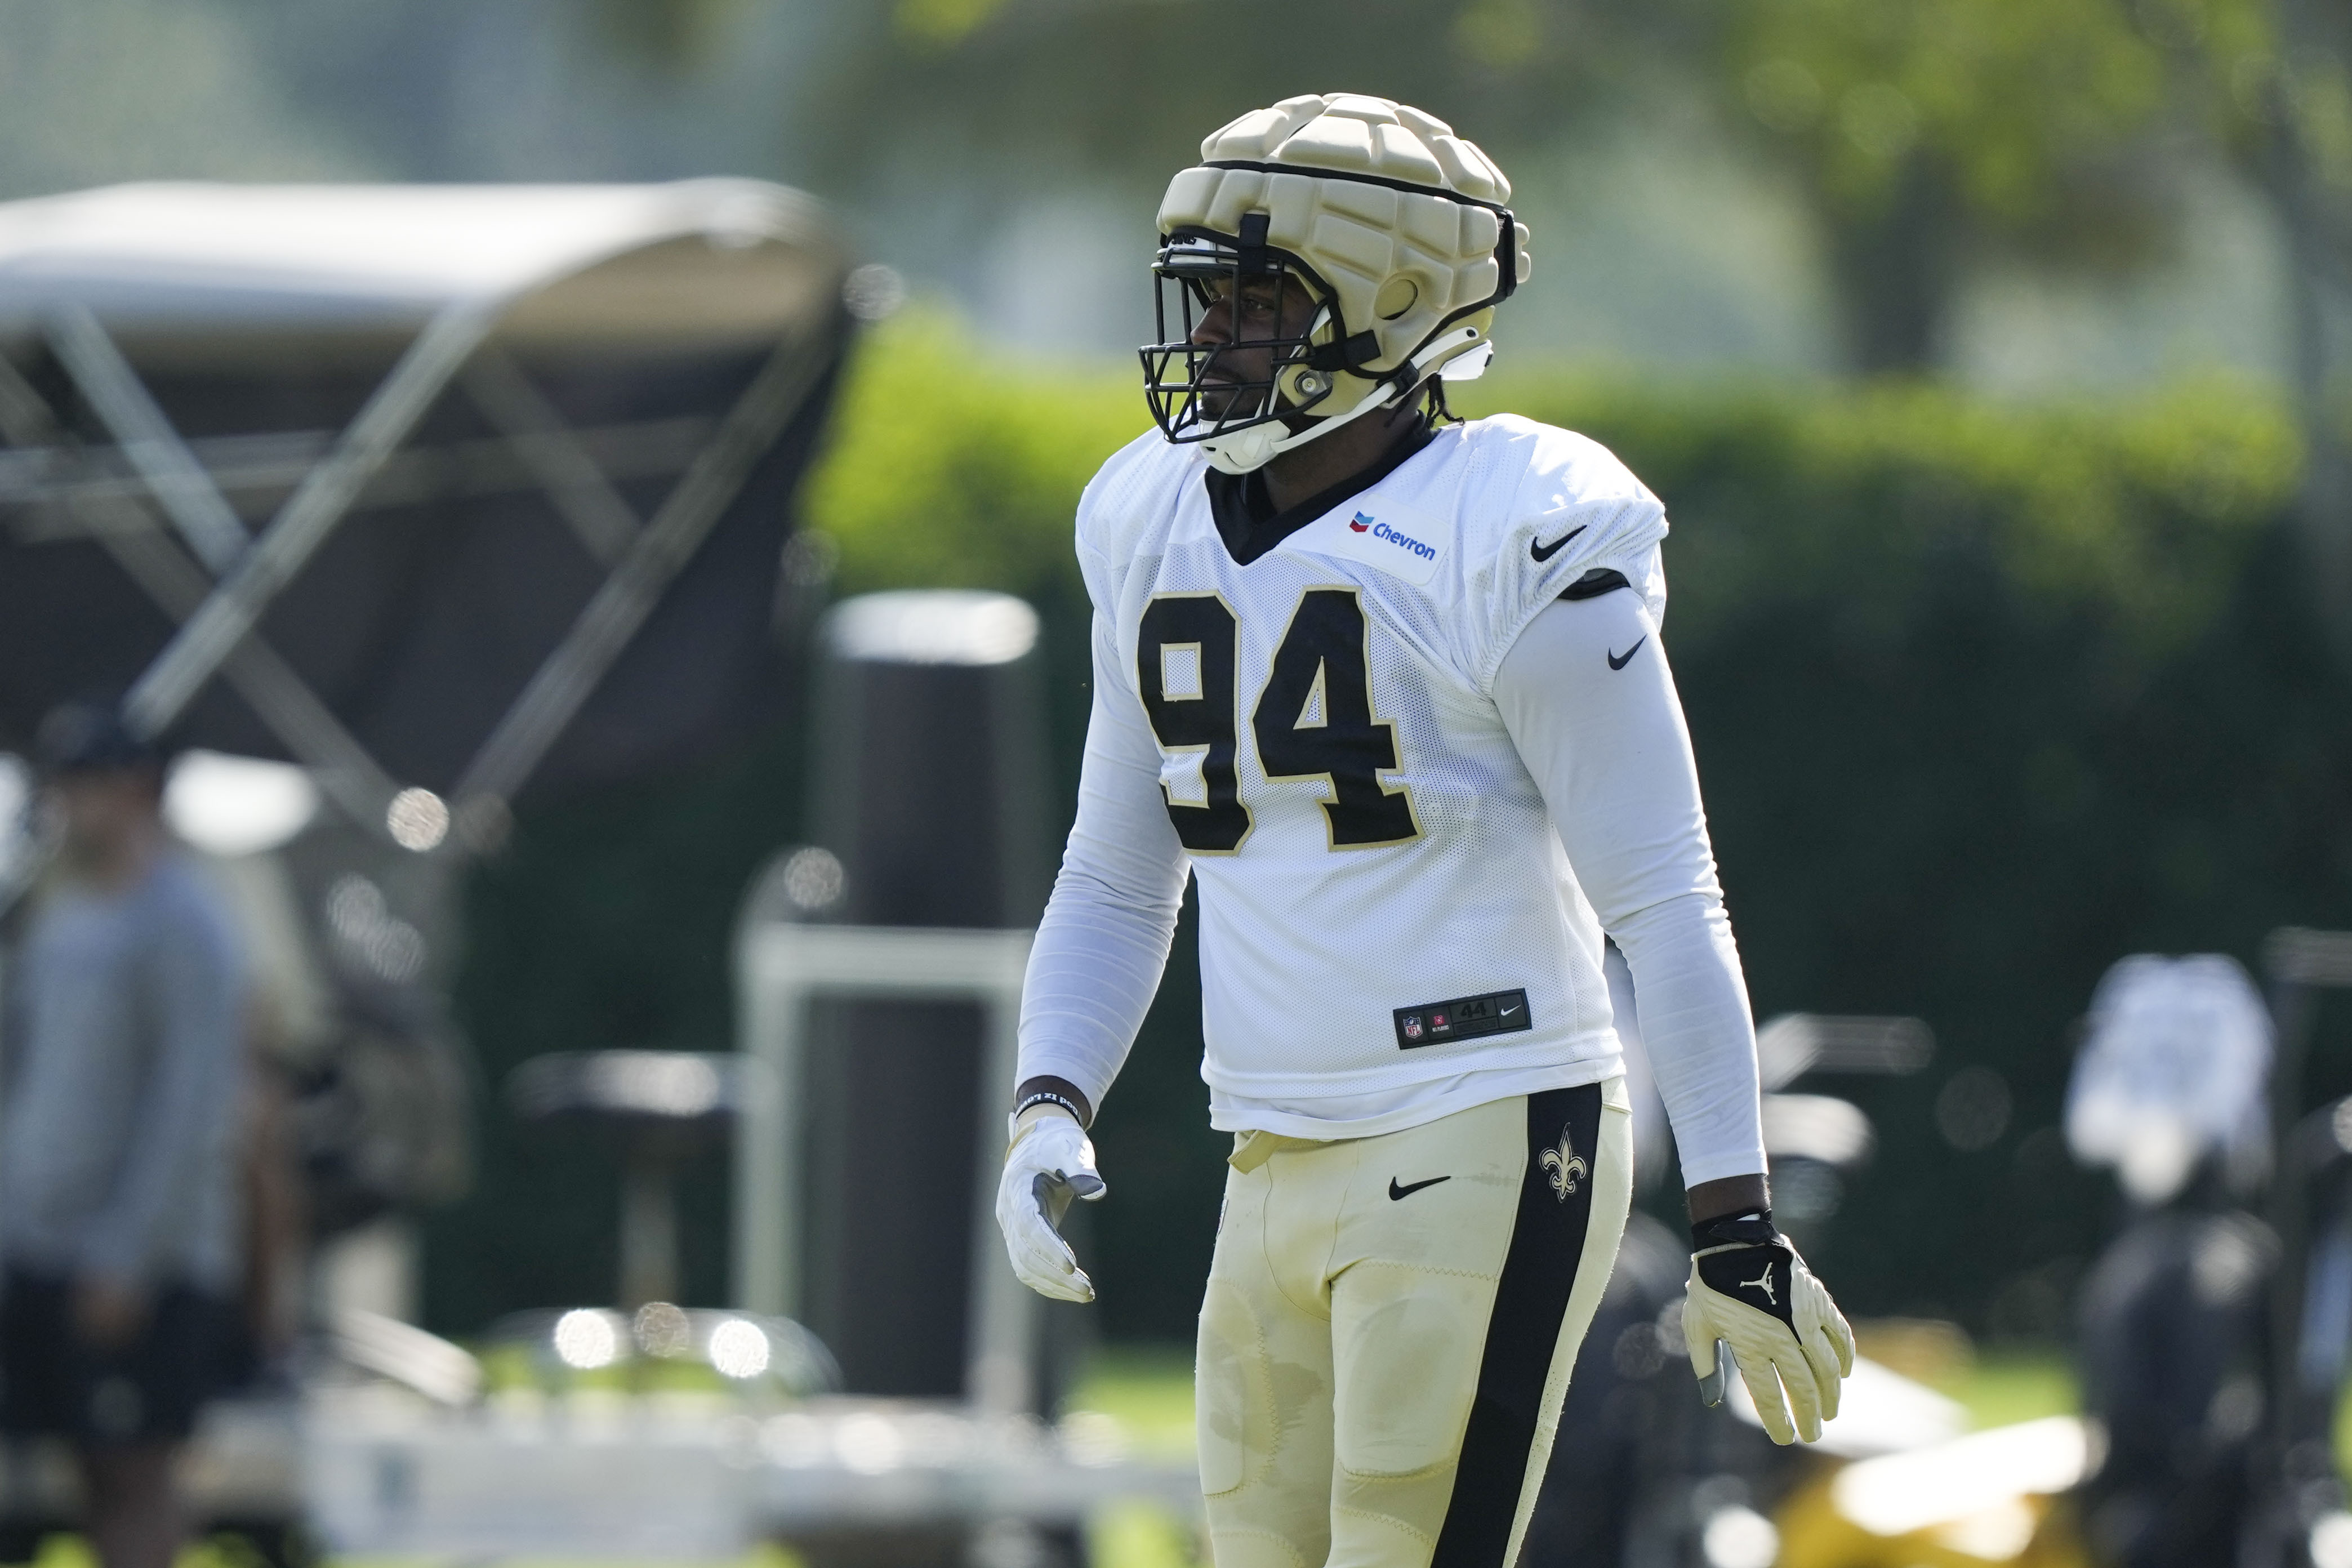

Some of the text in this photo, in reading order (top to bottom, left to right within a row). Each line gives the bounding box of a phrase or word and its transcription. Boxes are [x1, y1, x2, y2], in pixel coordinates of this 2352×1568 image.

[1373, 523, 1436, 561] Chevron
[1136, 584, 1428, 856] 94
[1461, 1001, 1486, 1018] 44
[1407, 1025, 1420, 1036] NFL
[1059, 1096, 1079, 1116] God
